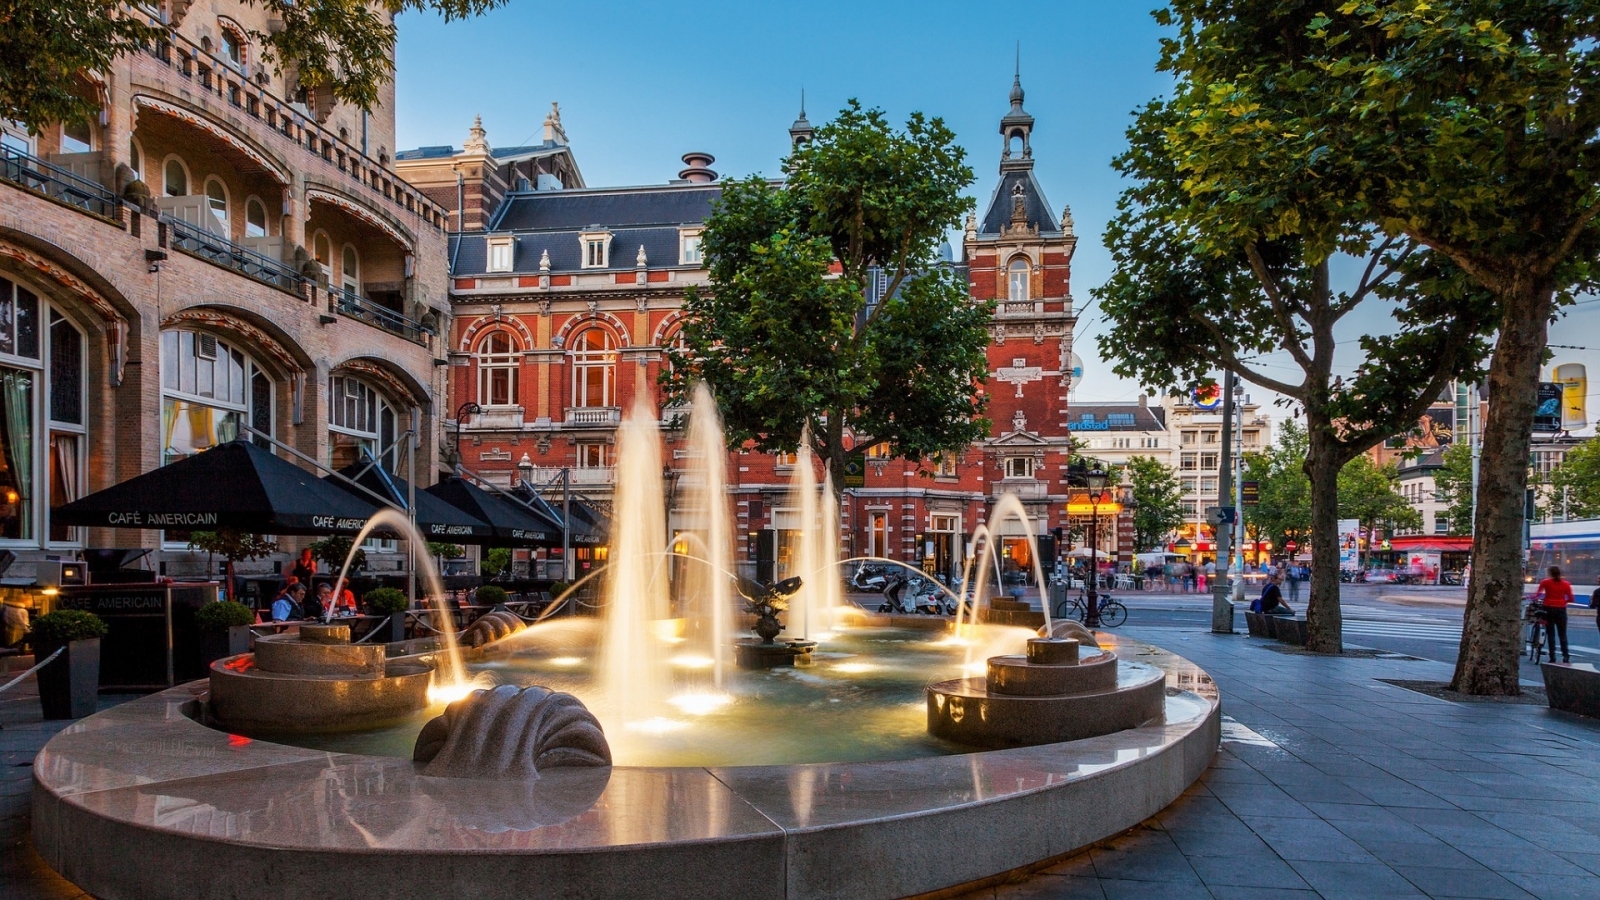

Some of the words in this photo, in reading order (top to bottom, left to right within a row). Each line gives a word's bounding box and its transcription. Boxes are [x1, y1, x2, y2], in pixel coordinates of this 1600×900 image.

[1067, 419, 1109, 430] andstad
[108, 511, 142, 524] CAFÉ
[147, 513, 217, 525] AMERICAIN
[312, 516, 335, 528] CAFÉ
[336, 518, 367, 529] AMERIC
[97, 596, 162, 608] AMERICAIN
